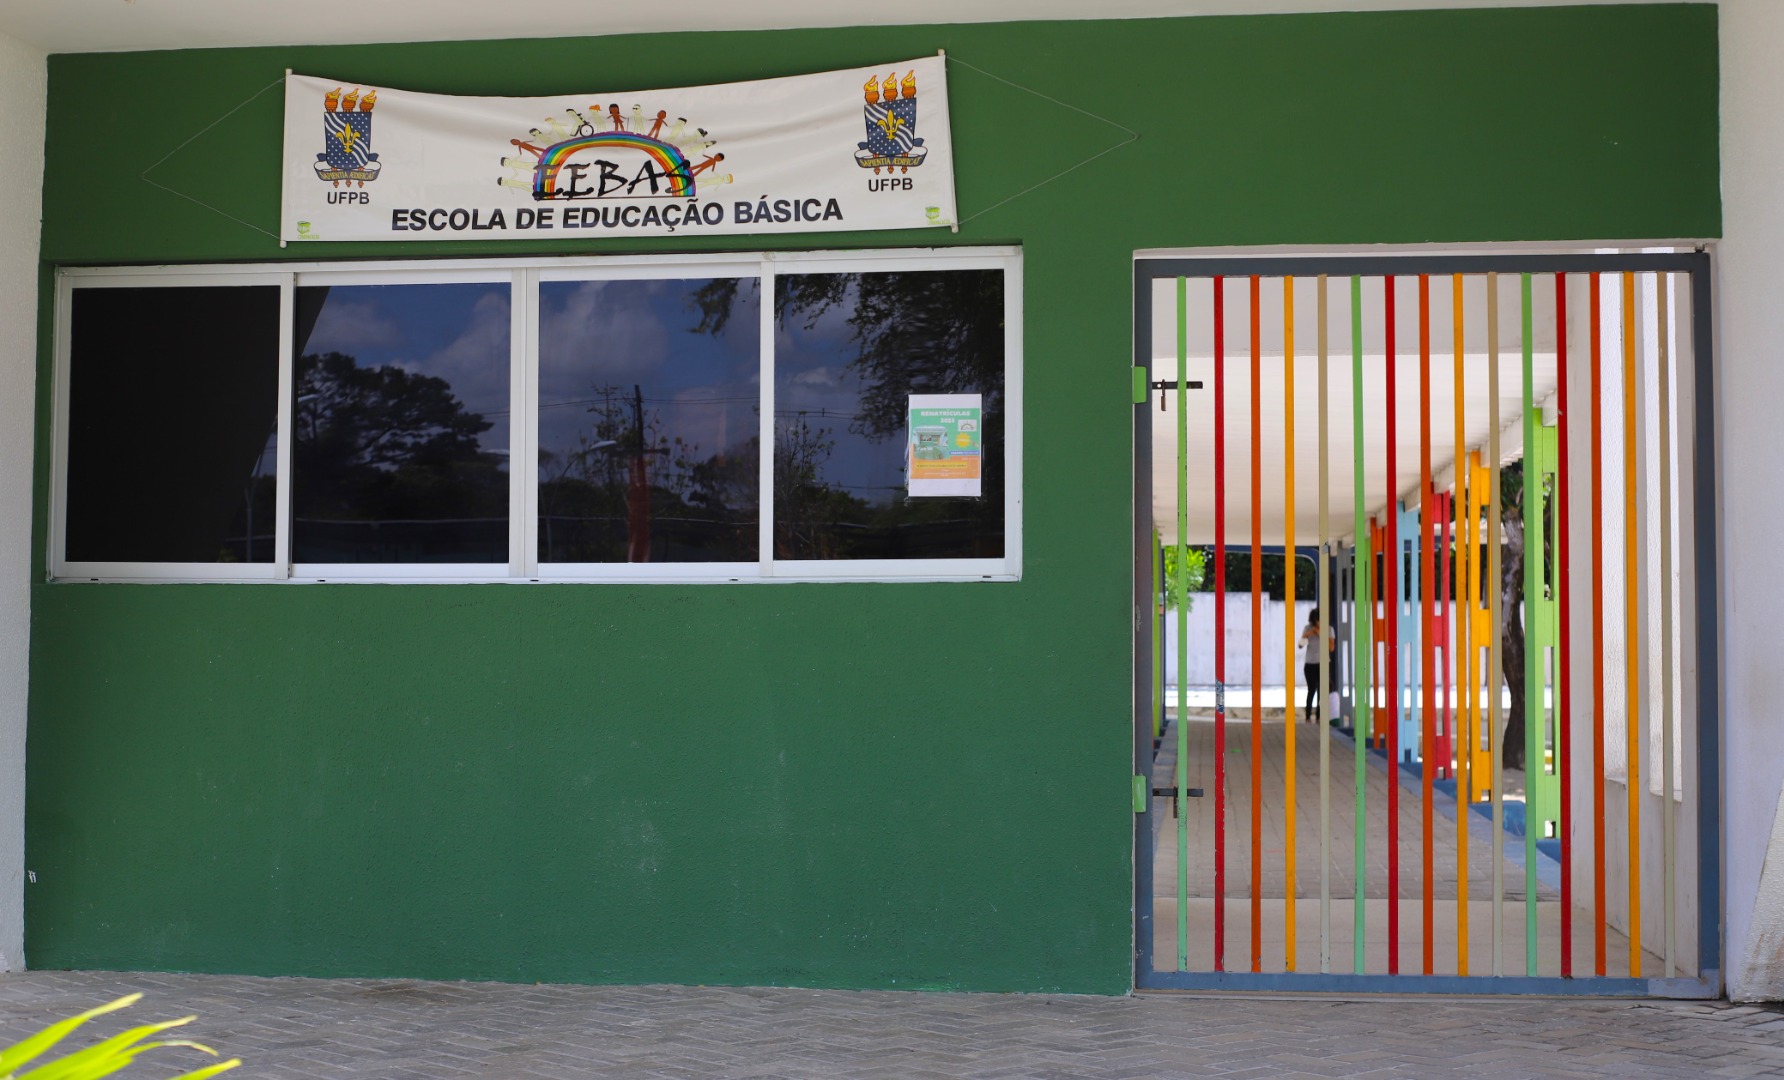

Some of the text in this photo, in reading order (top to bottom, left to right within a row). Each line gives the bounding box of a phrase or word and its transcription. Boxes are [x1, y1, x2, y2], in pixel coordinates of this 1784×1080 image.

[868, 177, 913, 192] UFPB
[327, 191, 370, 205] UFPB
[391, 194, 844, 232] ESCOLA DE EDUCAÇÃO BÁSICA
